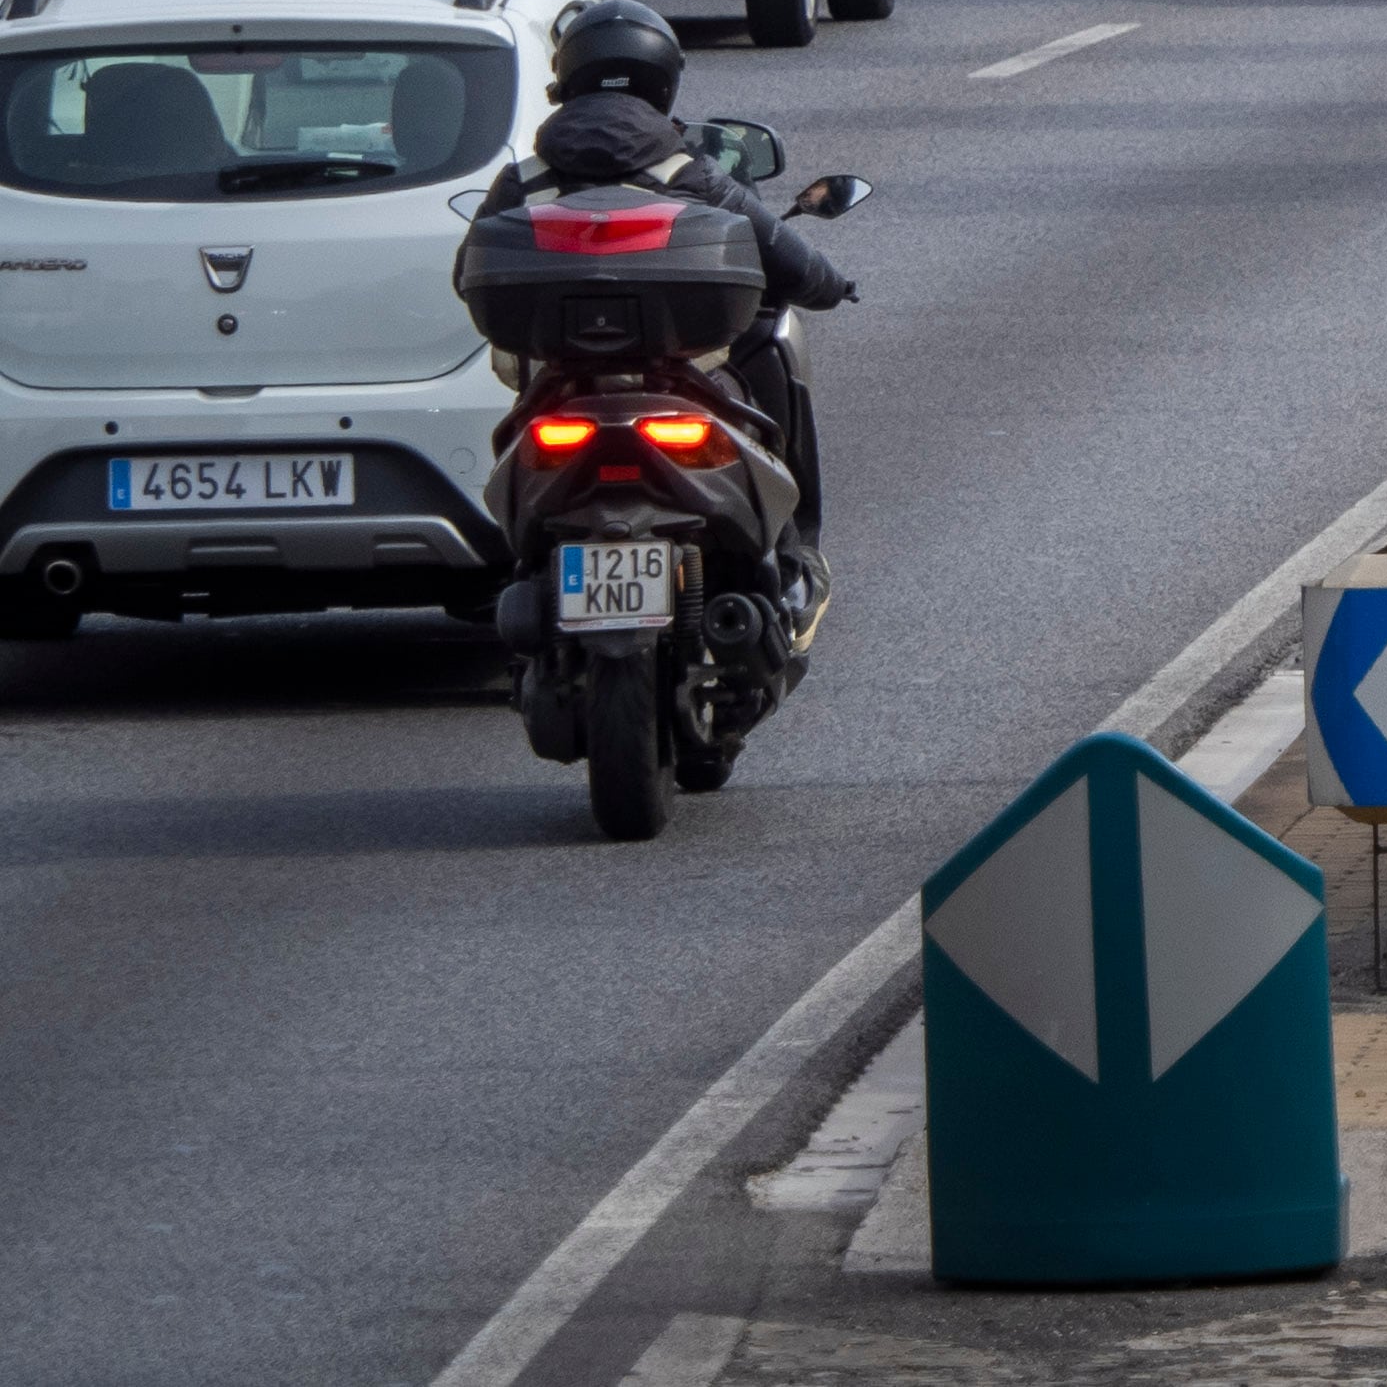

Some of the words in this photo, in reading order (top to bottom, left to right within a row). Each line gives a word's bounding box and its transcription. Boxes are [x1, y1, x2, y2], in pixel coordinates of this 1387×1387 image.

[143, 461, 247, 500] 4654
[264, 459, 343, 499] LKW
[590, 548, 663, 580] 1216
[586, 581, 644, 613] KND
